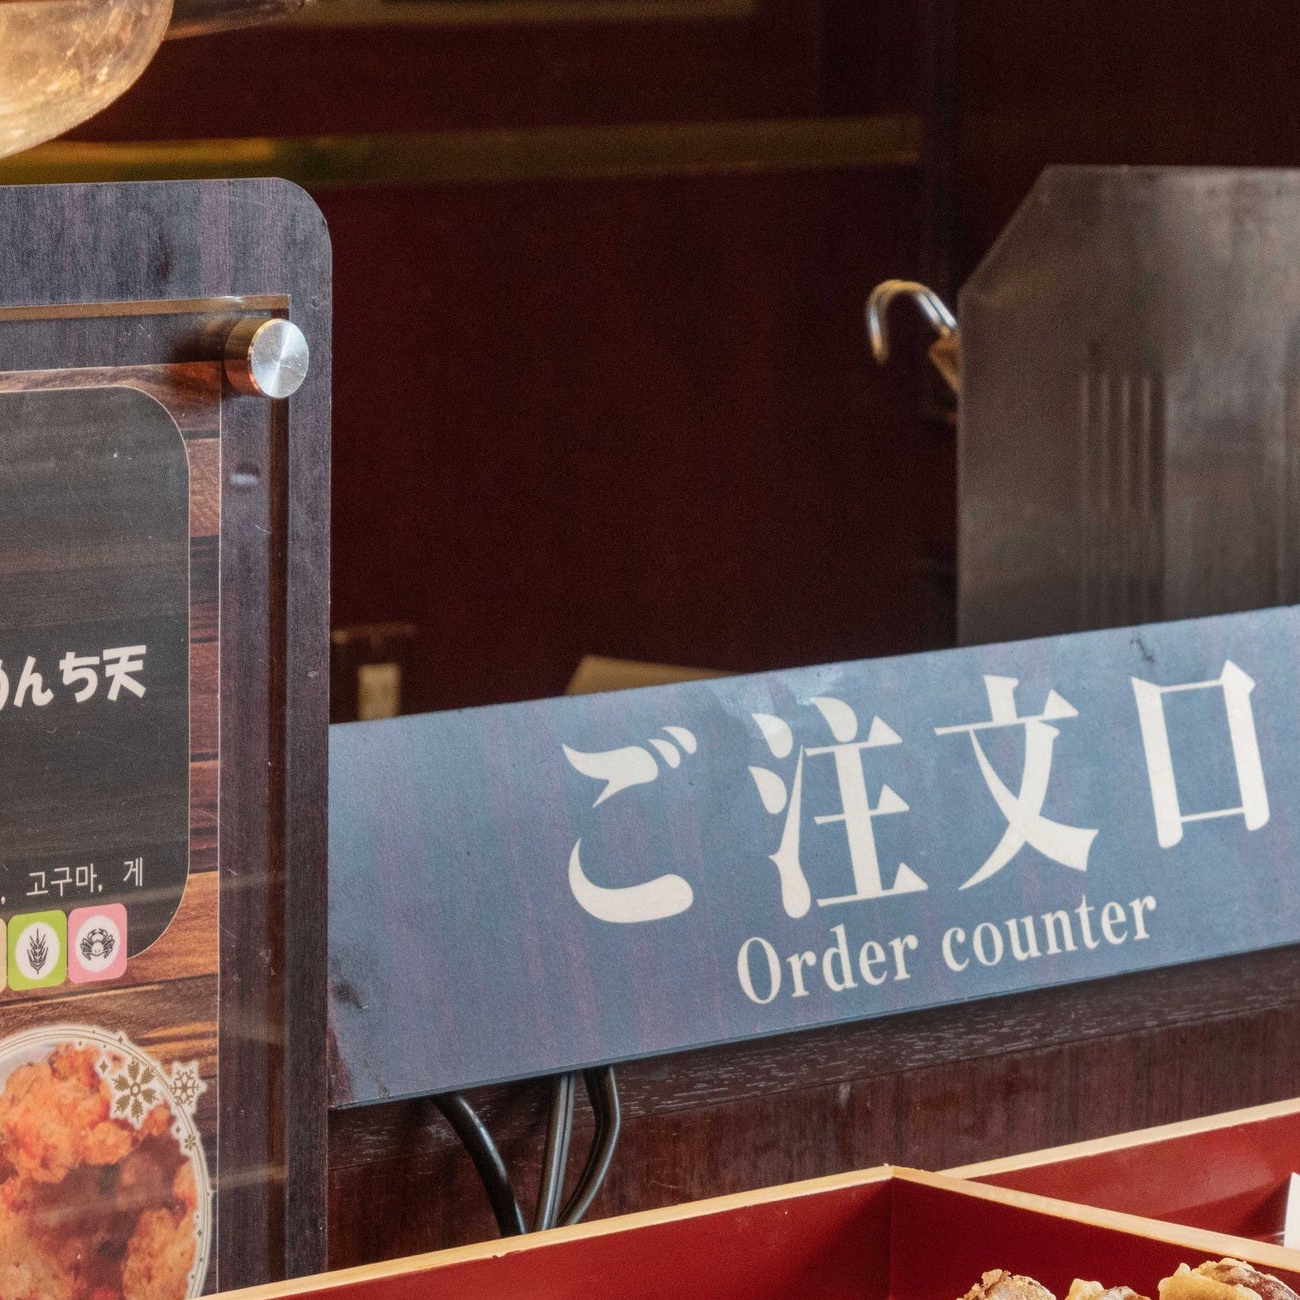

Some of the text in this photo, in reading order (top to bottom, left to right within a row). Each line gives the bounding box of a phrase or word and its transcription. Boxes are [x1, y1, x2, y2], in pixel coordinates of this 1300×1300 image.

[561, 659, 1270, 923] ご注文口
[25, 863, 103, 897] 고구마,
[122, 856, 144, 888] 게
[736, 894, 1157, 1005] Order counter
